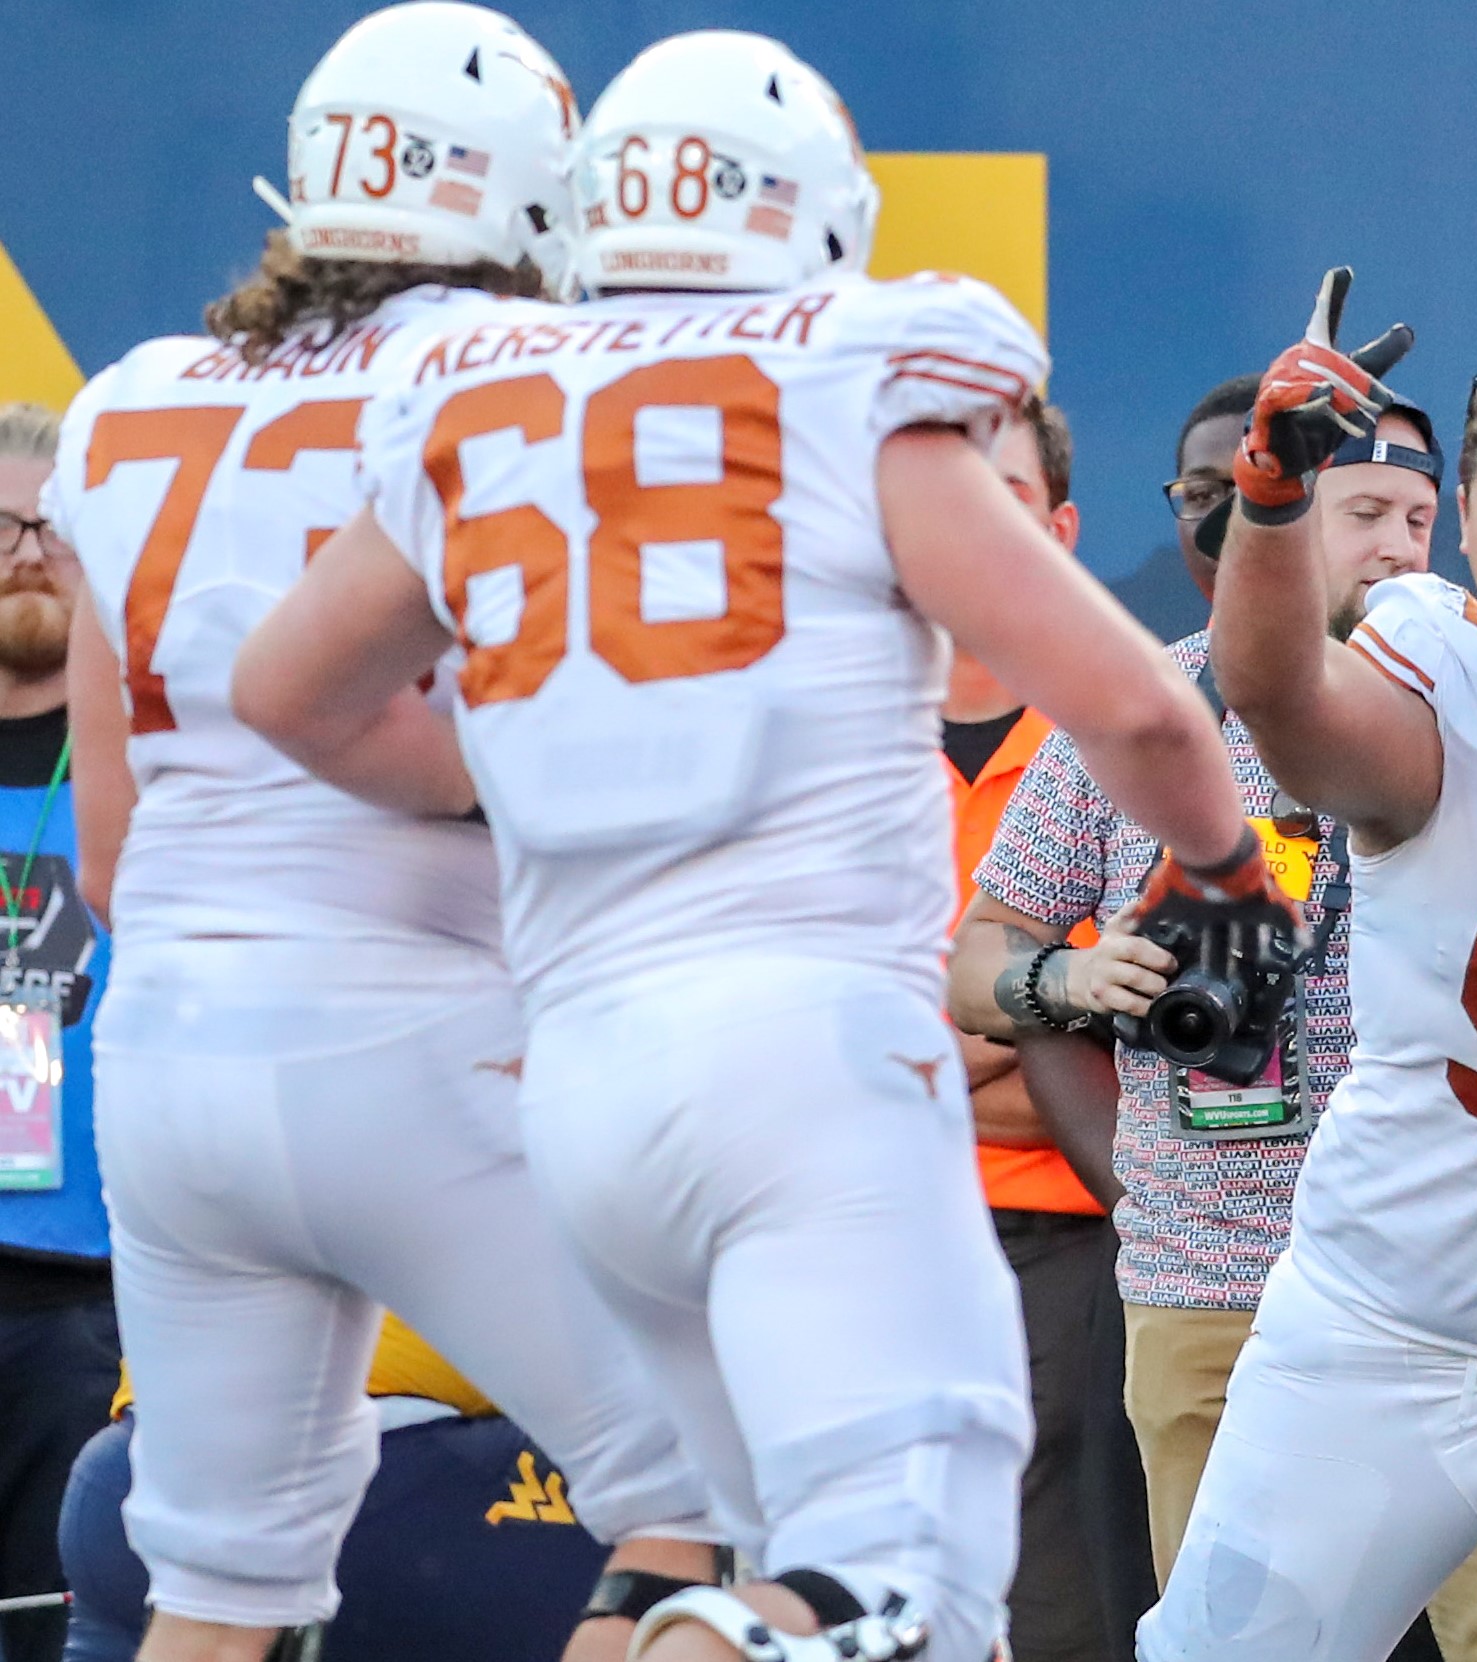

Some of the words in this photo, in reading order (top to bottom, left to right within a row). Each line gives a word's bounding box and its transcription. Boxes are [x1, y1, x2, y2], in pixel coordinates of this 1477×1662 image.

[326, 112, 397, 200] 73
[618, 135, 711, 220] 68
[422, 353, 787, 708] 68
